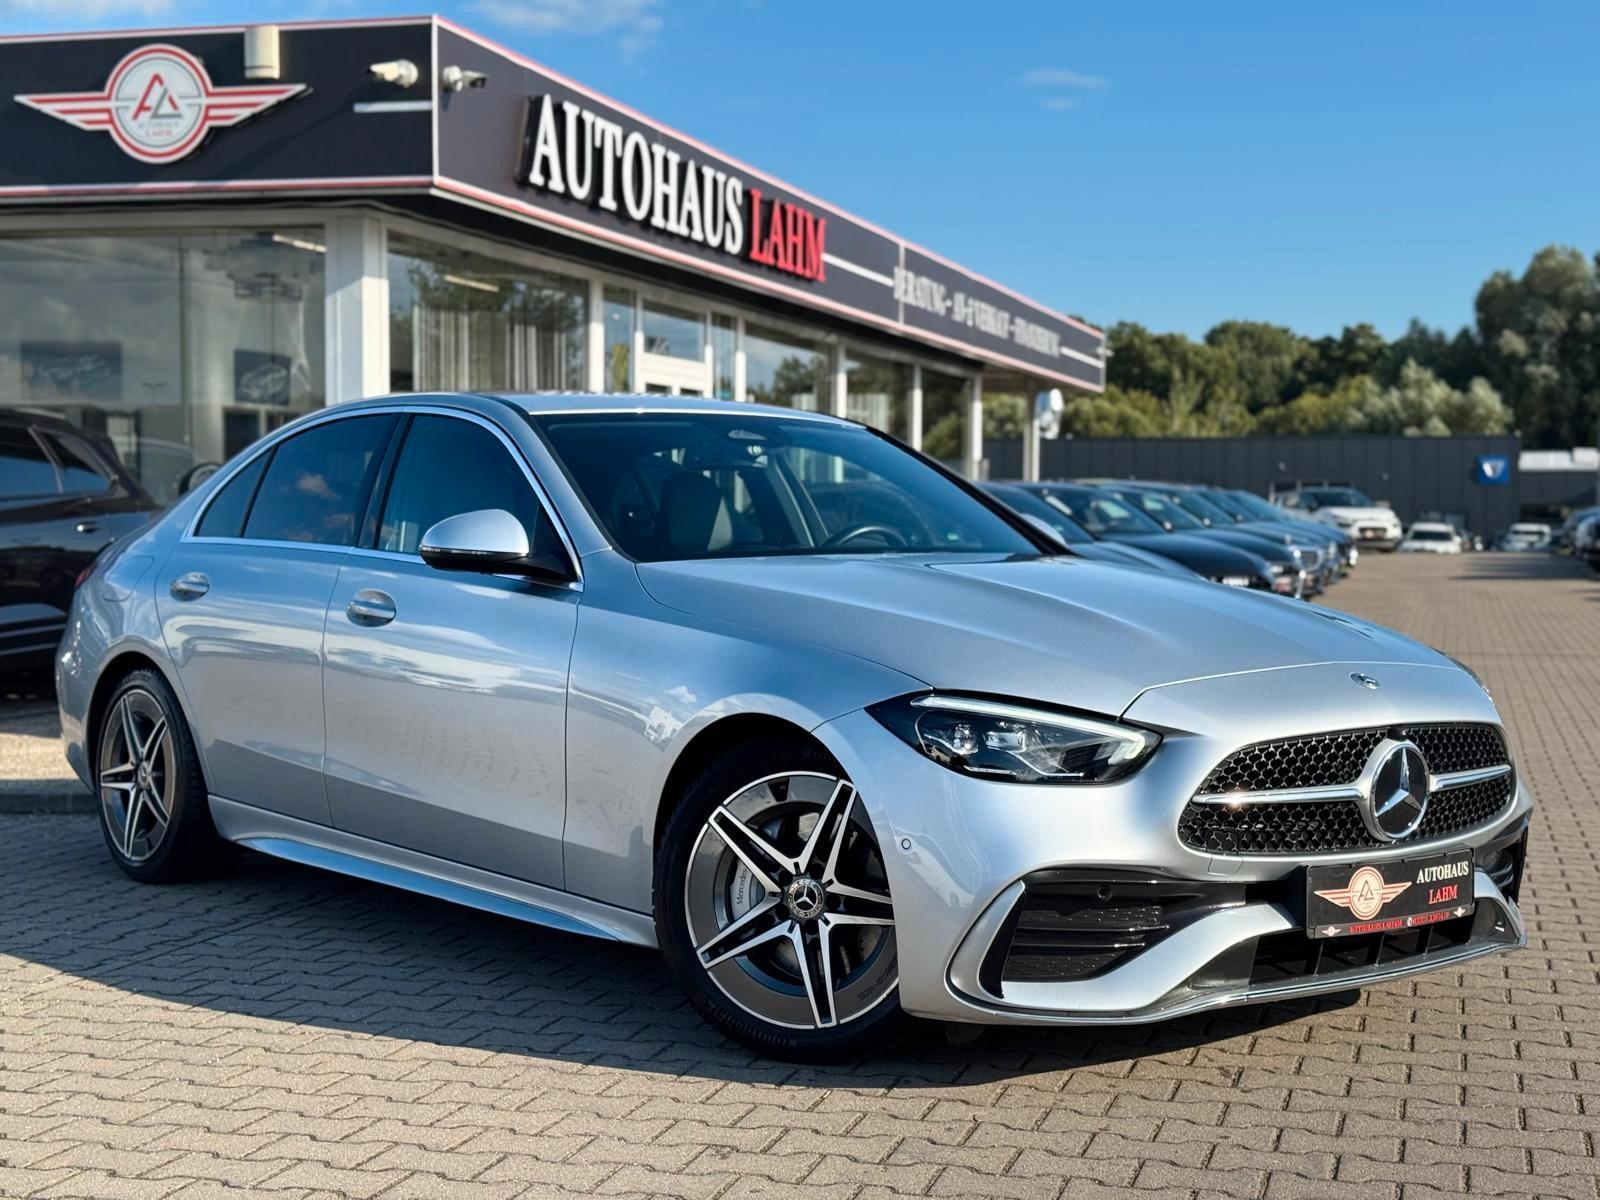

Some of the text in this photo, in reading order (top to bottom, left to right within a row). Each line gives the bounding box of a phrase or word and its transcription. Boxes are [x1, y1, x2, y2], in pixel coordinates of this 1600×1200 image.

[529, 93, 826, 282] AUTOHAUS LAHM
[1416, 860, 1469, 884] AUTOHAUS
[1428, 884, 1458, 905] LAHM
